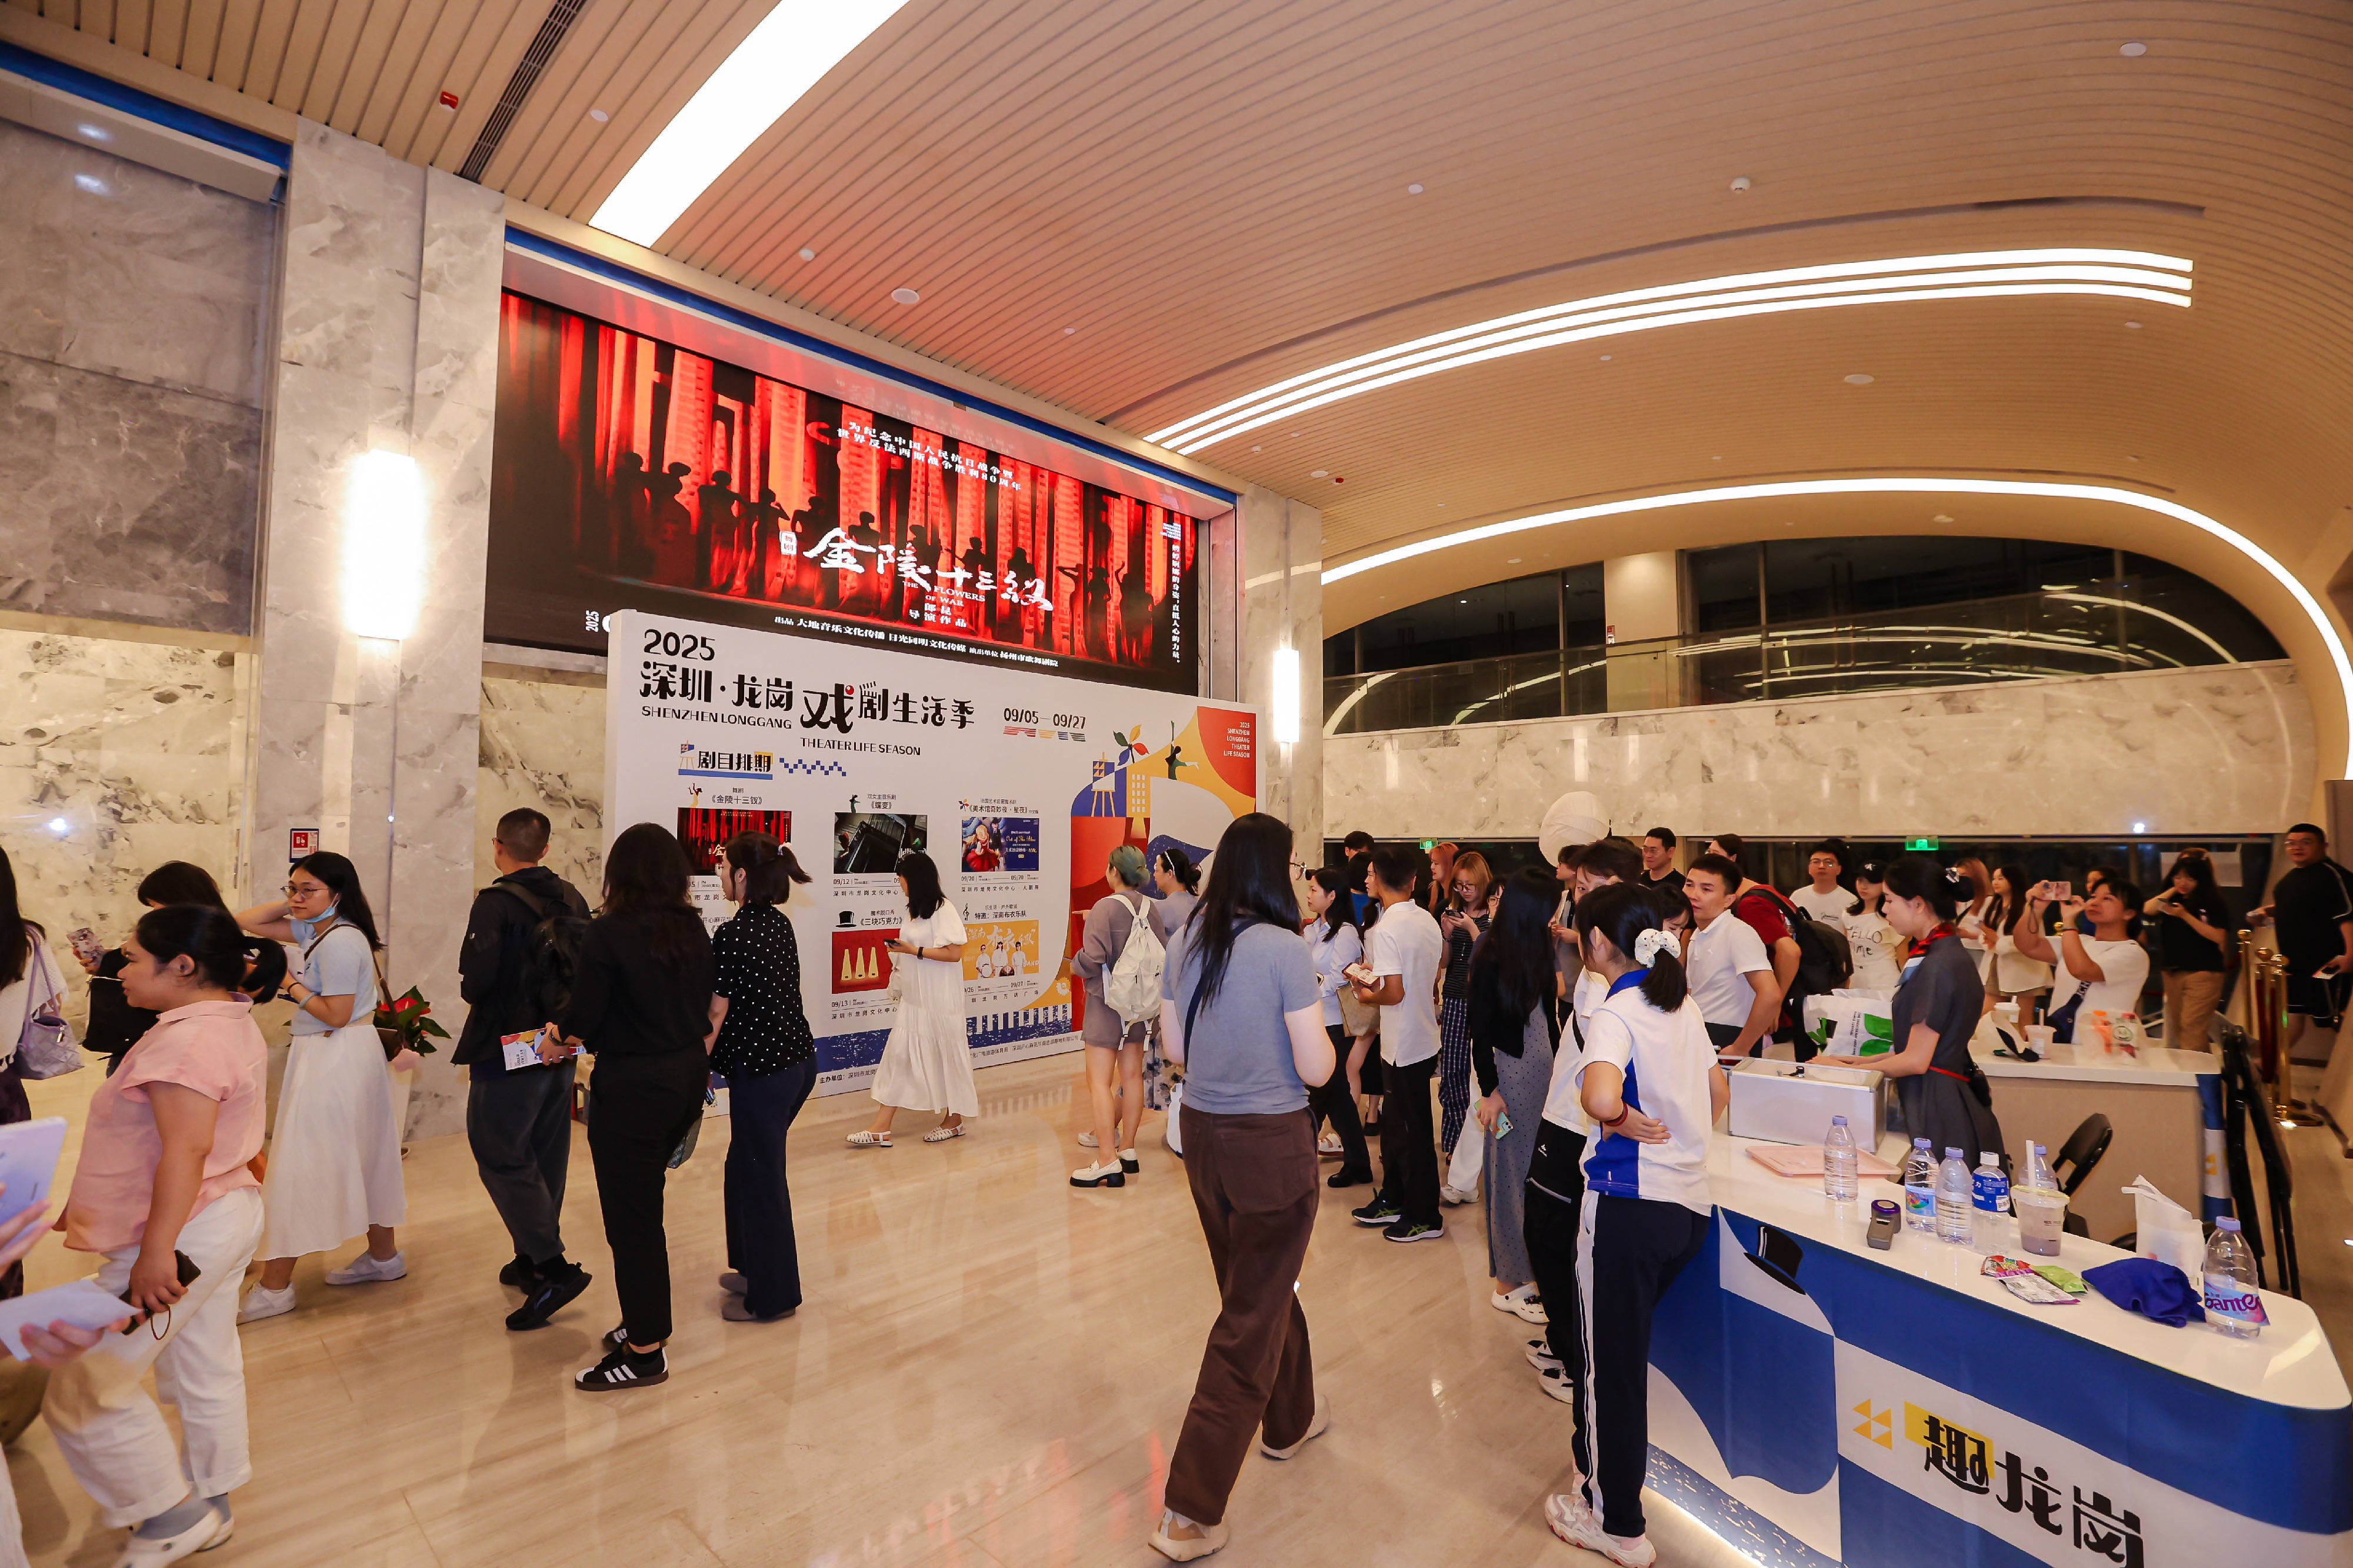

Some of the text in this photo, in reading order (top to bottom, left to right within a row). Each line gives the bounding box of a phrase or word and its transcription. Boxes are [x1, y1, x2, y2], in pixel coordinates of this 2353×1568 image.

[836, 428, 1021, 491] 世界反法西斯战争胜利80周年
[848, 421, 1013, 479] 为纪念中国人民抗日战争暨
[902, 580, 985, 602] THE FLOWERS
[939, 595, 964, 607] WAR
[585, 610, 599, 632] 2025
[797, 618, 885, 640] 大地音乐文化传播
[909, 609, 967, 628] 导演作品
[644, 629, 716, 661] 2025
[642, 706, 792, 729] SHENZHEN LONGGANG
[801, 737, 921, 756] THEATER LIFE SEASON
[1227, 735, 1250, 743] LONGGANG
[698, 750, 771, 772] 剧目排期
[711, 795, 763, 805] 《金陵十三钗》
[860, 916, 902, 926] 《三块巧克力》
[831, 1000, 848, 1008] 09/13
[848, 1068, 878, 1079] 深圳市龙岗
[1923, 1414, 2144, 1568] 趣龙岗
